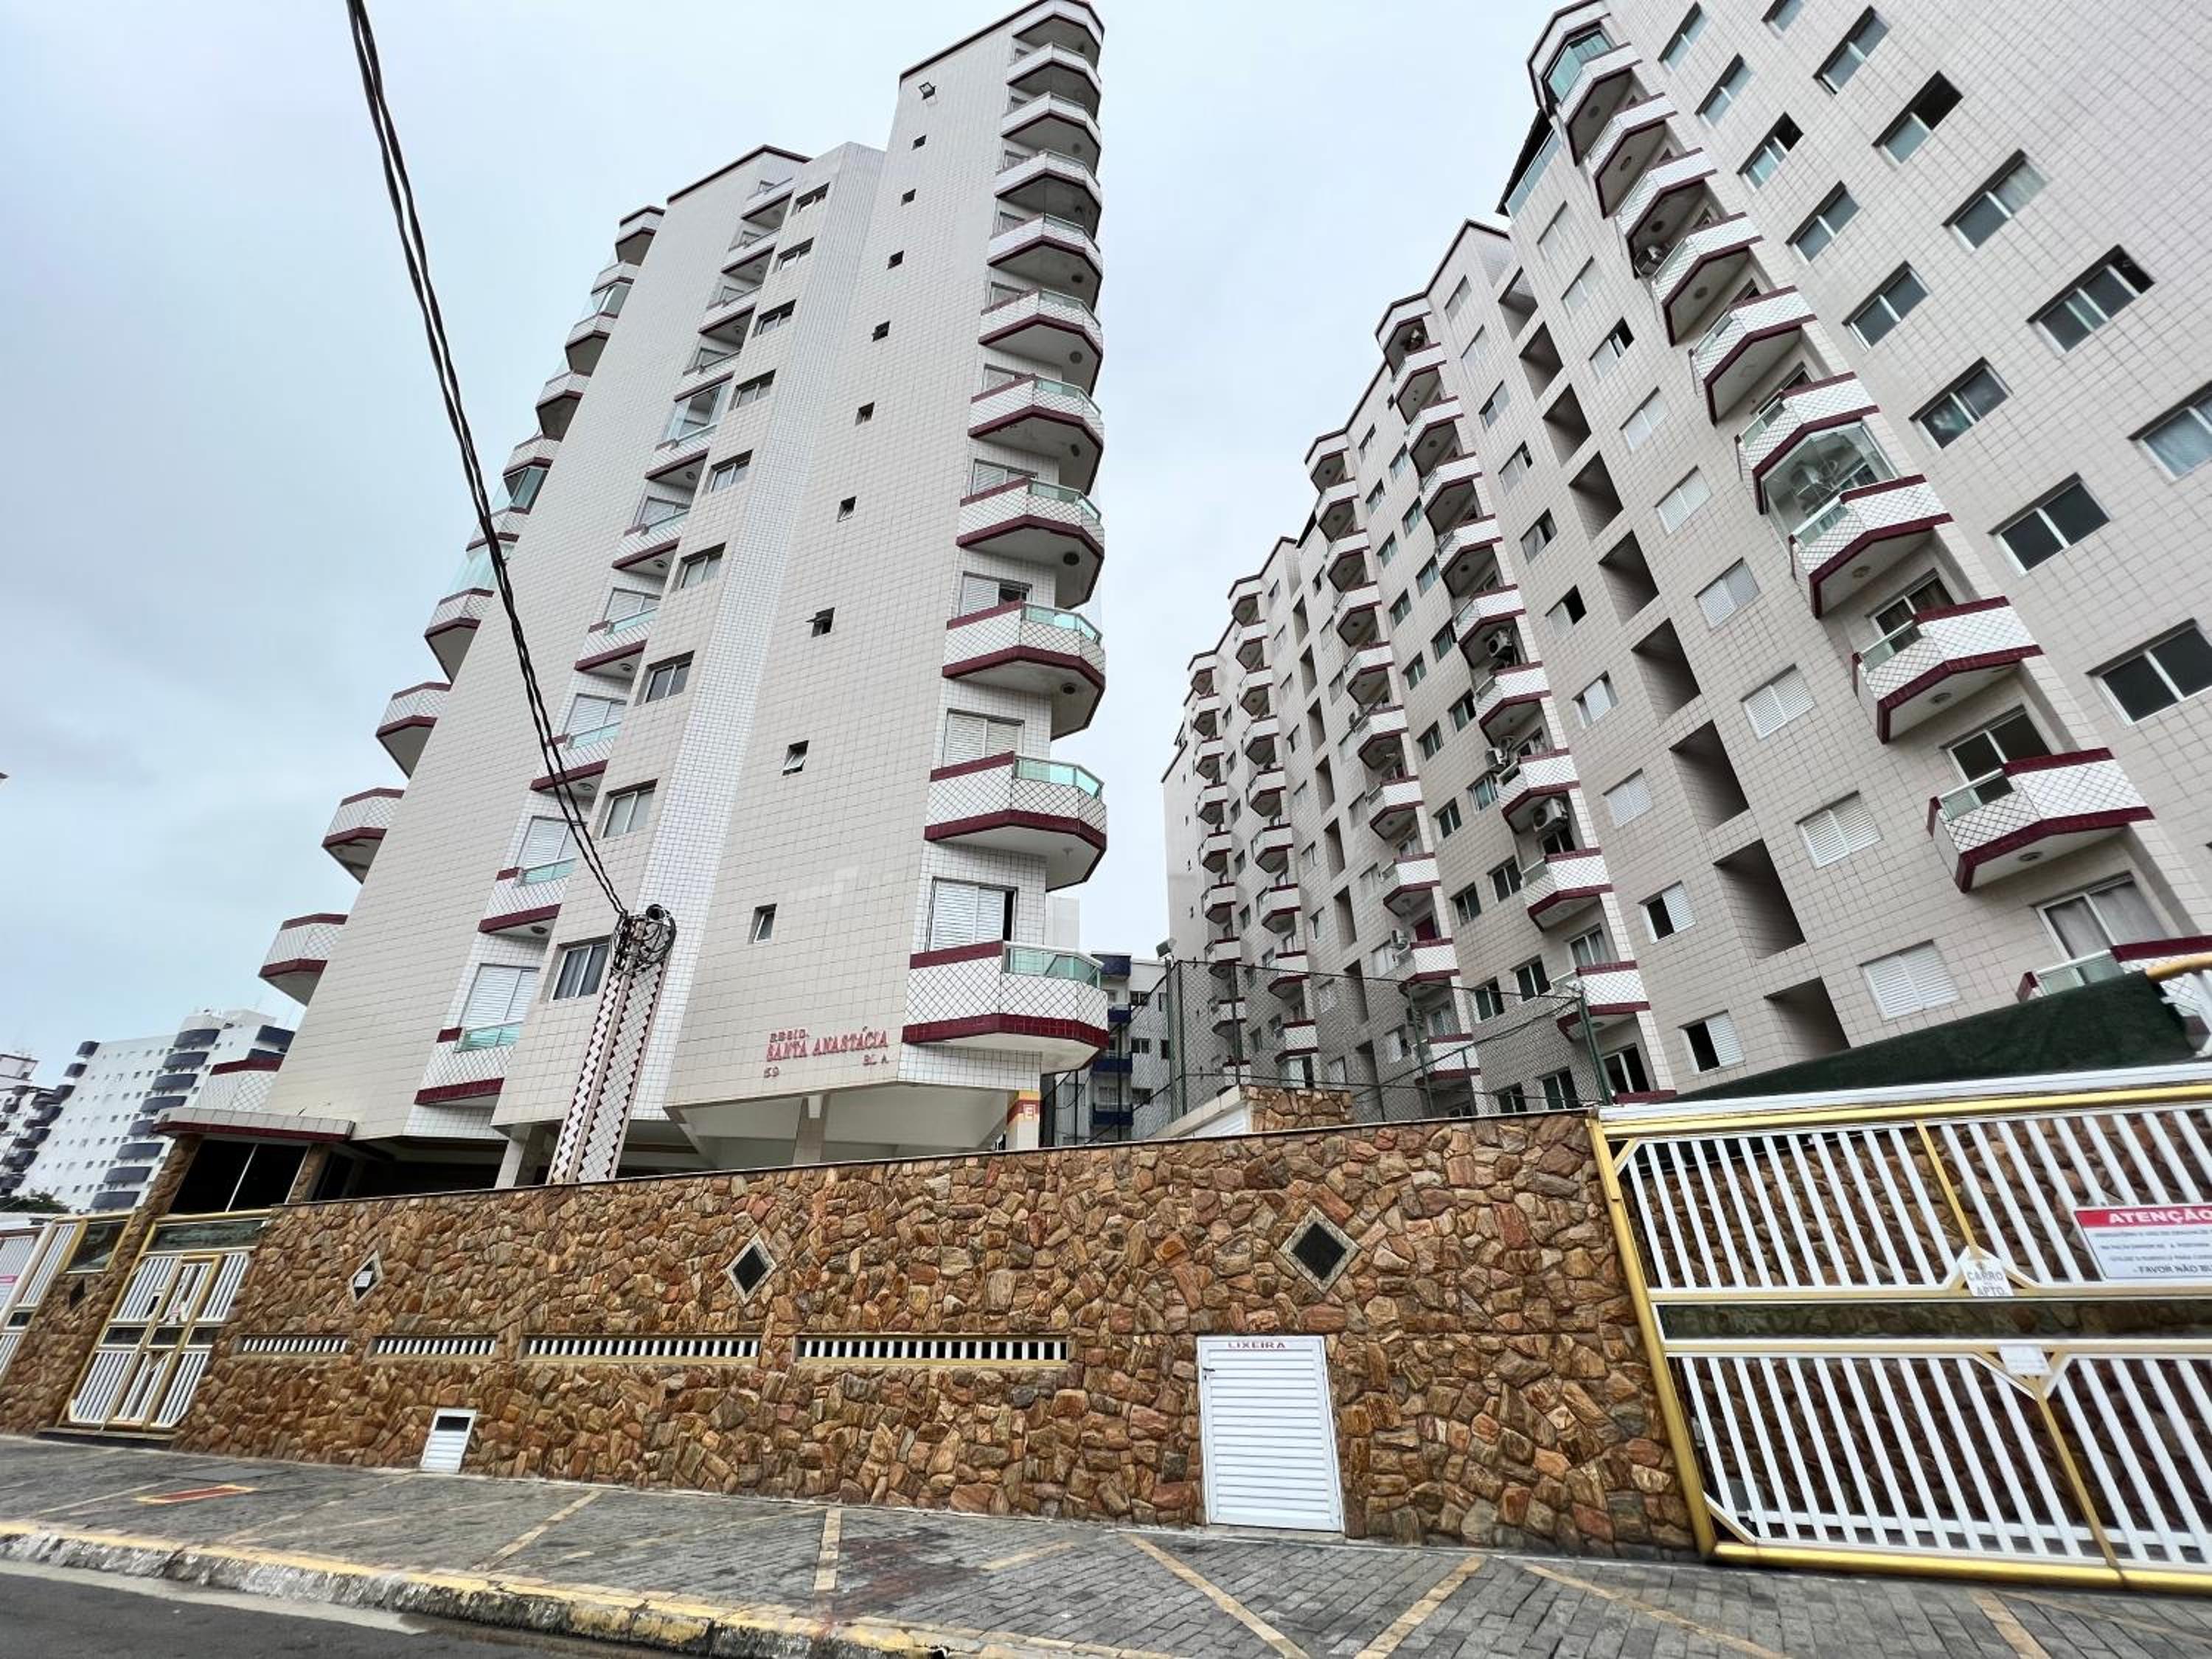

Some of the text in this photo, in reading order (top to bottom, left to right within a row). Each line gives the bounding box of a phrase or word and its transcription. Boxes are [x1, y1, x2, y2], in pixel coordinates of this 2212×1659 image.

[767, 1026, 888, 1062] SANTA ANASTÁCIA
[2109, 1207, 2212, 1223] ATENÇÃO
[2174, 1263, 2199, 1273] NÃO
[1967, 1271, 2003, 1281] CARRO
